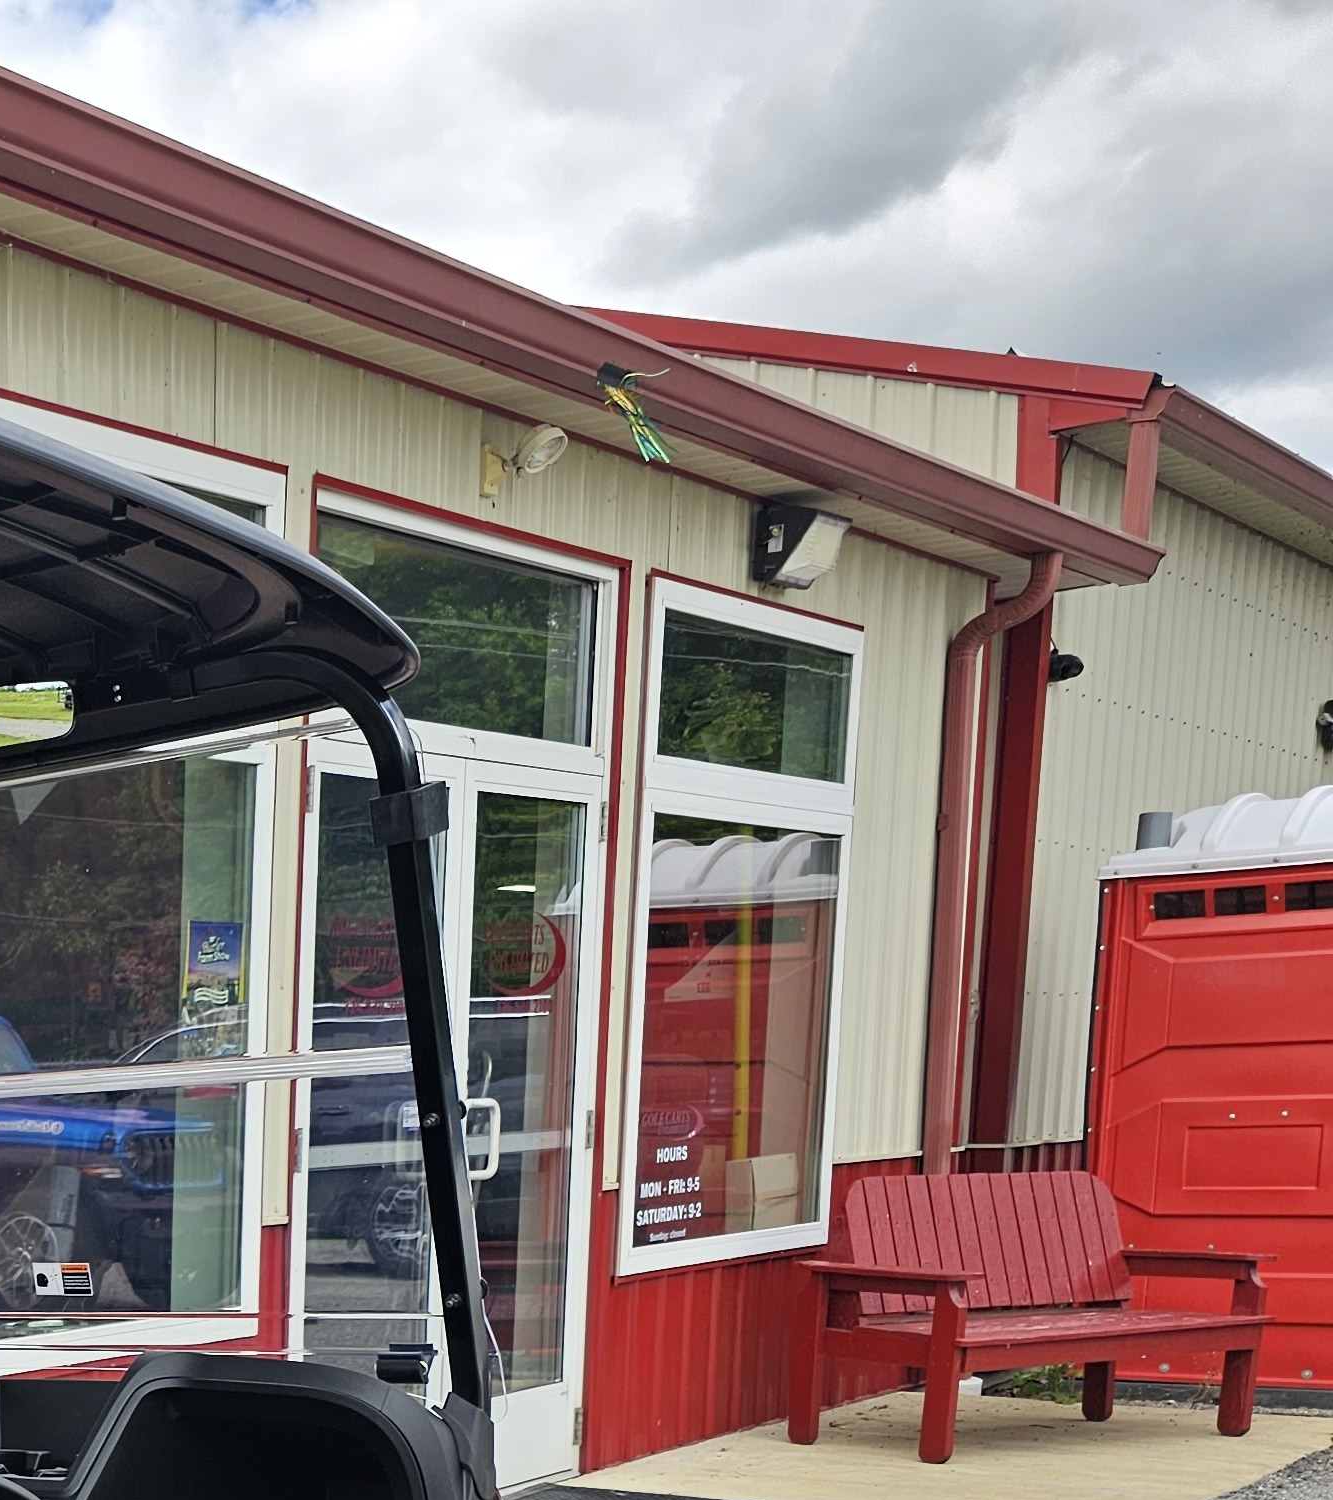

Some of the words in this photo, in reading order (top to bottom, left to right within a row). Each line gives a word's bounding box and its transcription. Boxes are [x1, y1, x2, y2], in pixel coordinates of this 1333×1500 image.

[656, 1145, 688, 1163] HOURS
[640, 1181, 662, 1199] MON
[668, 1178, 686, 1194] FRI:
[686, 1176, 700, 1193] 9-5
[636, 1204, 688, 1227] SATURDAY:
[688, 1201, 702, 1218] 9-2
